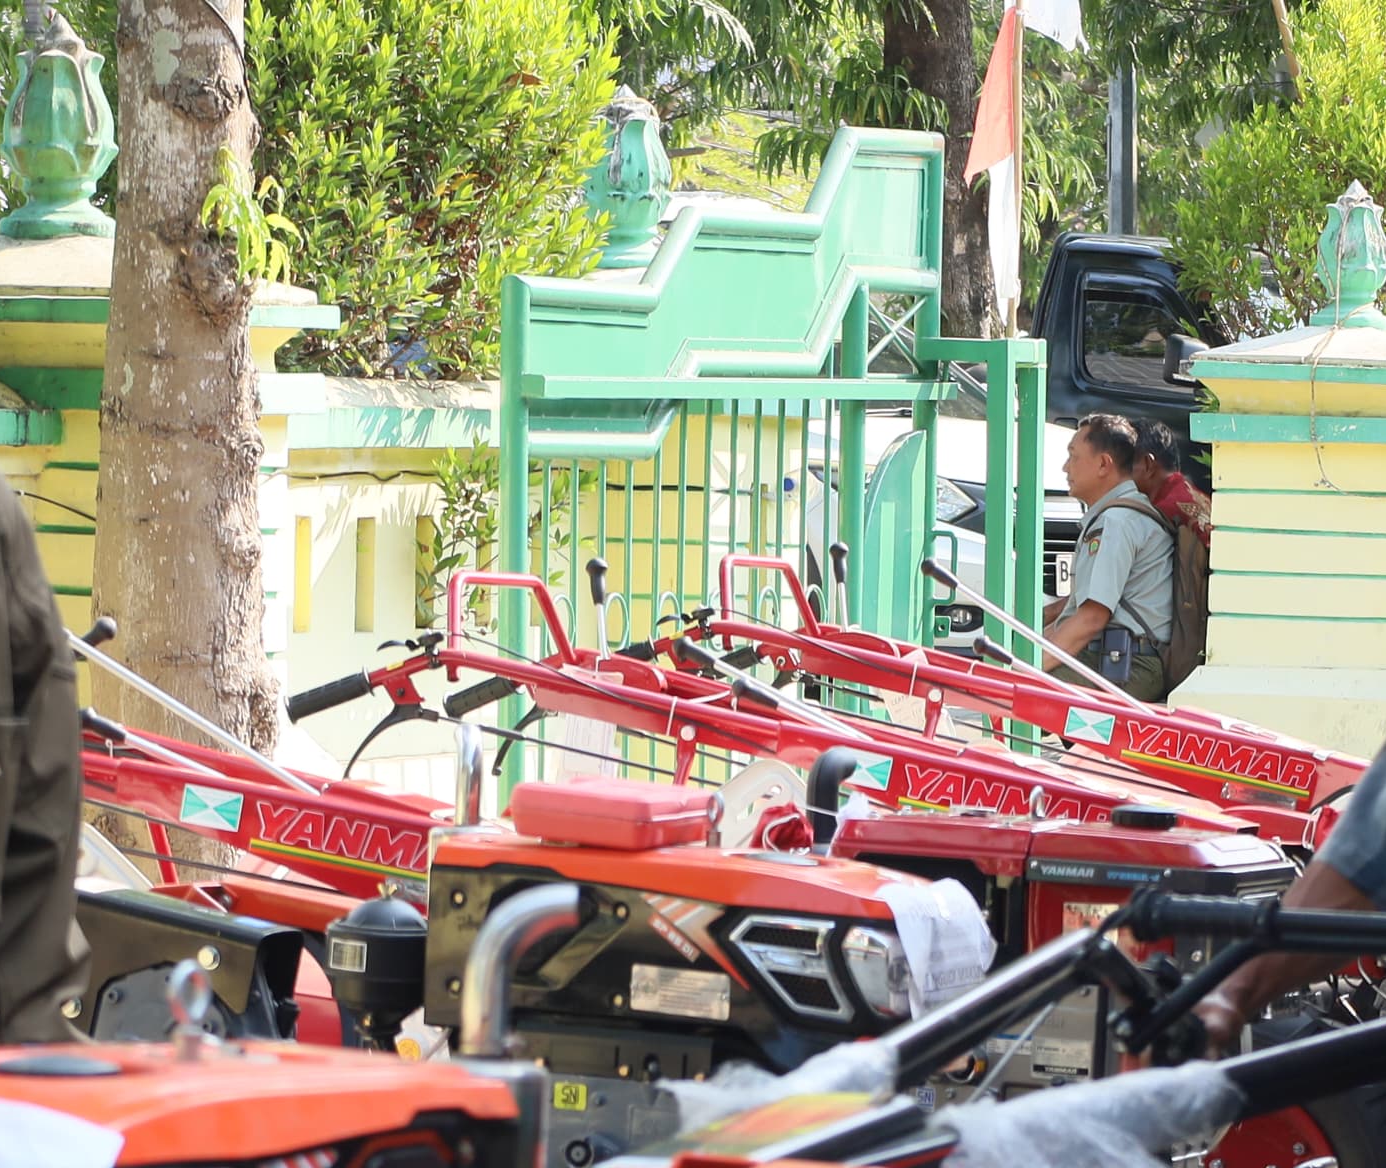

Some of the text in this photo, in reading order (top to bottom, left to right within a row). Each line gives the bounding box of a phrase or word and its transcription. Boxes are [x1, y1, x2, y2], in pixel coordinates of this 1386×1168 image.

[1127, 720, 1316, 789] YANMAR
[256, 801, 428, 872] YANM
[1040, 865, 1095, 878] YANMAR
[561, 1085, 580, 1105] SNI
